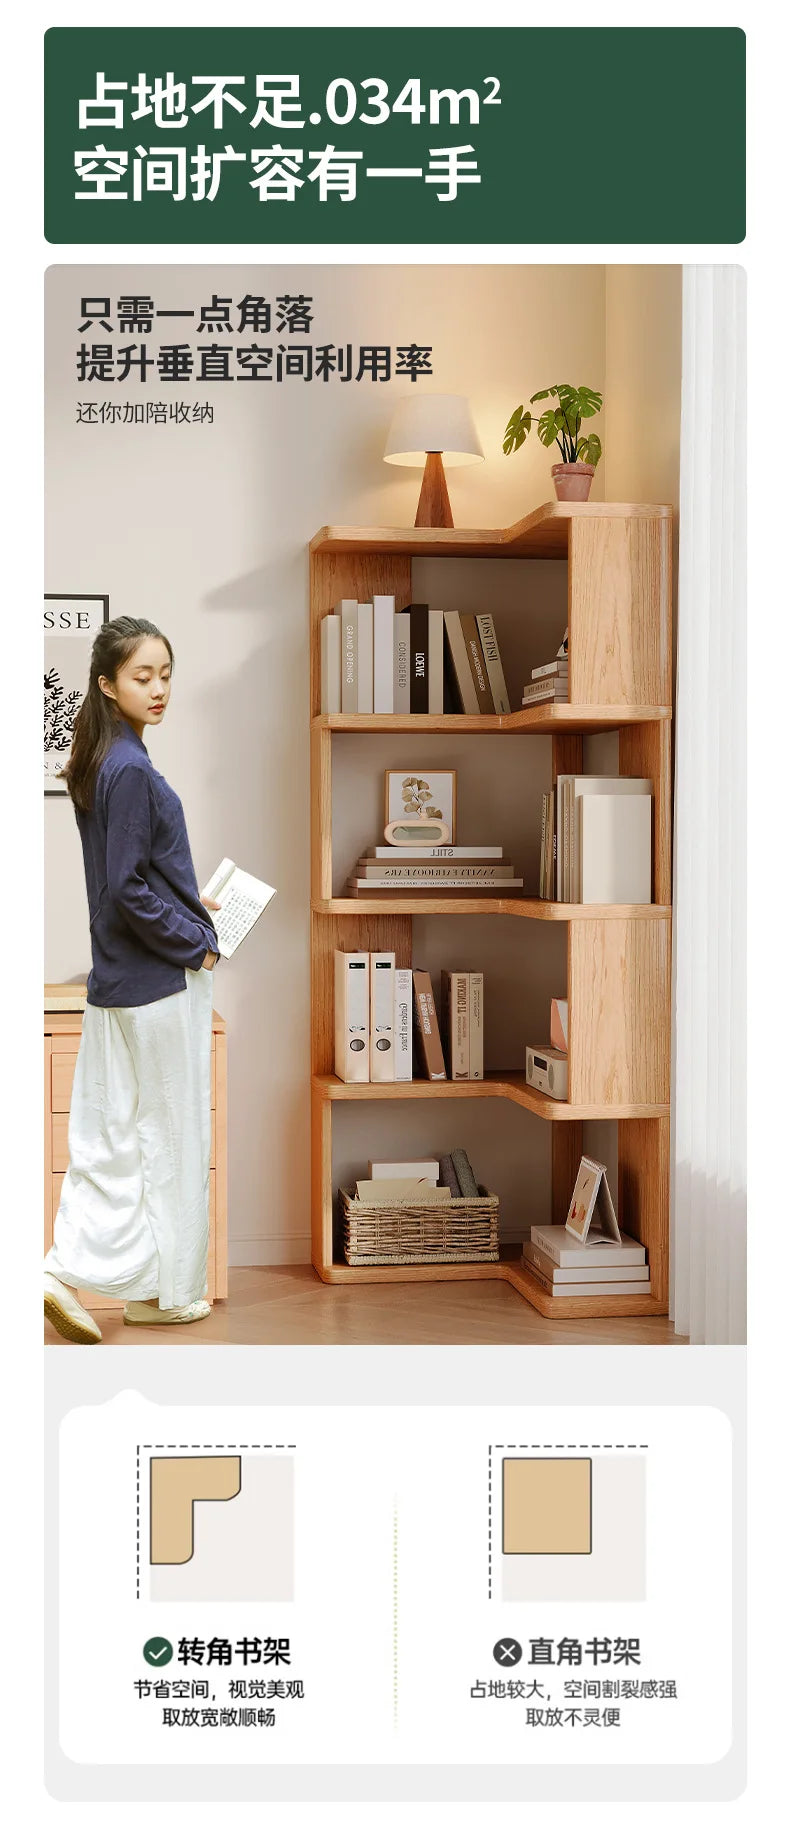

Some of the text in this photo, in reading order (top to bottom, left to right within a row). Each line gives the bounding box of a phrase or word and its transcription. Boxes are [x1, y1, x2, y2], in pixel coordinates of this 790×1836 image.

[44, 612, 90, 629] SSE
[480, 616, 493, 640] LOST
[398, 641, 407, 688] CONSIDERED
[415, 652, 425, 678] LOEWE
